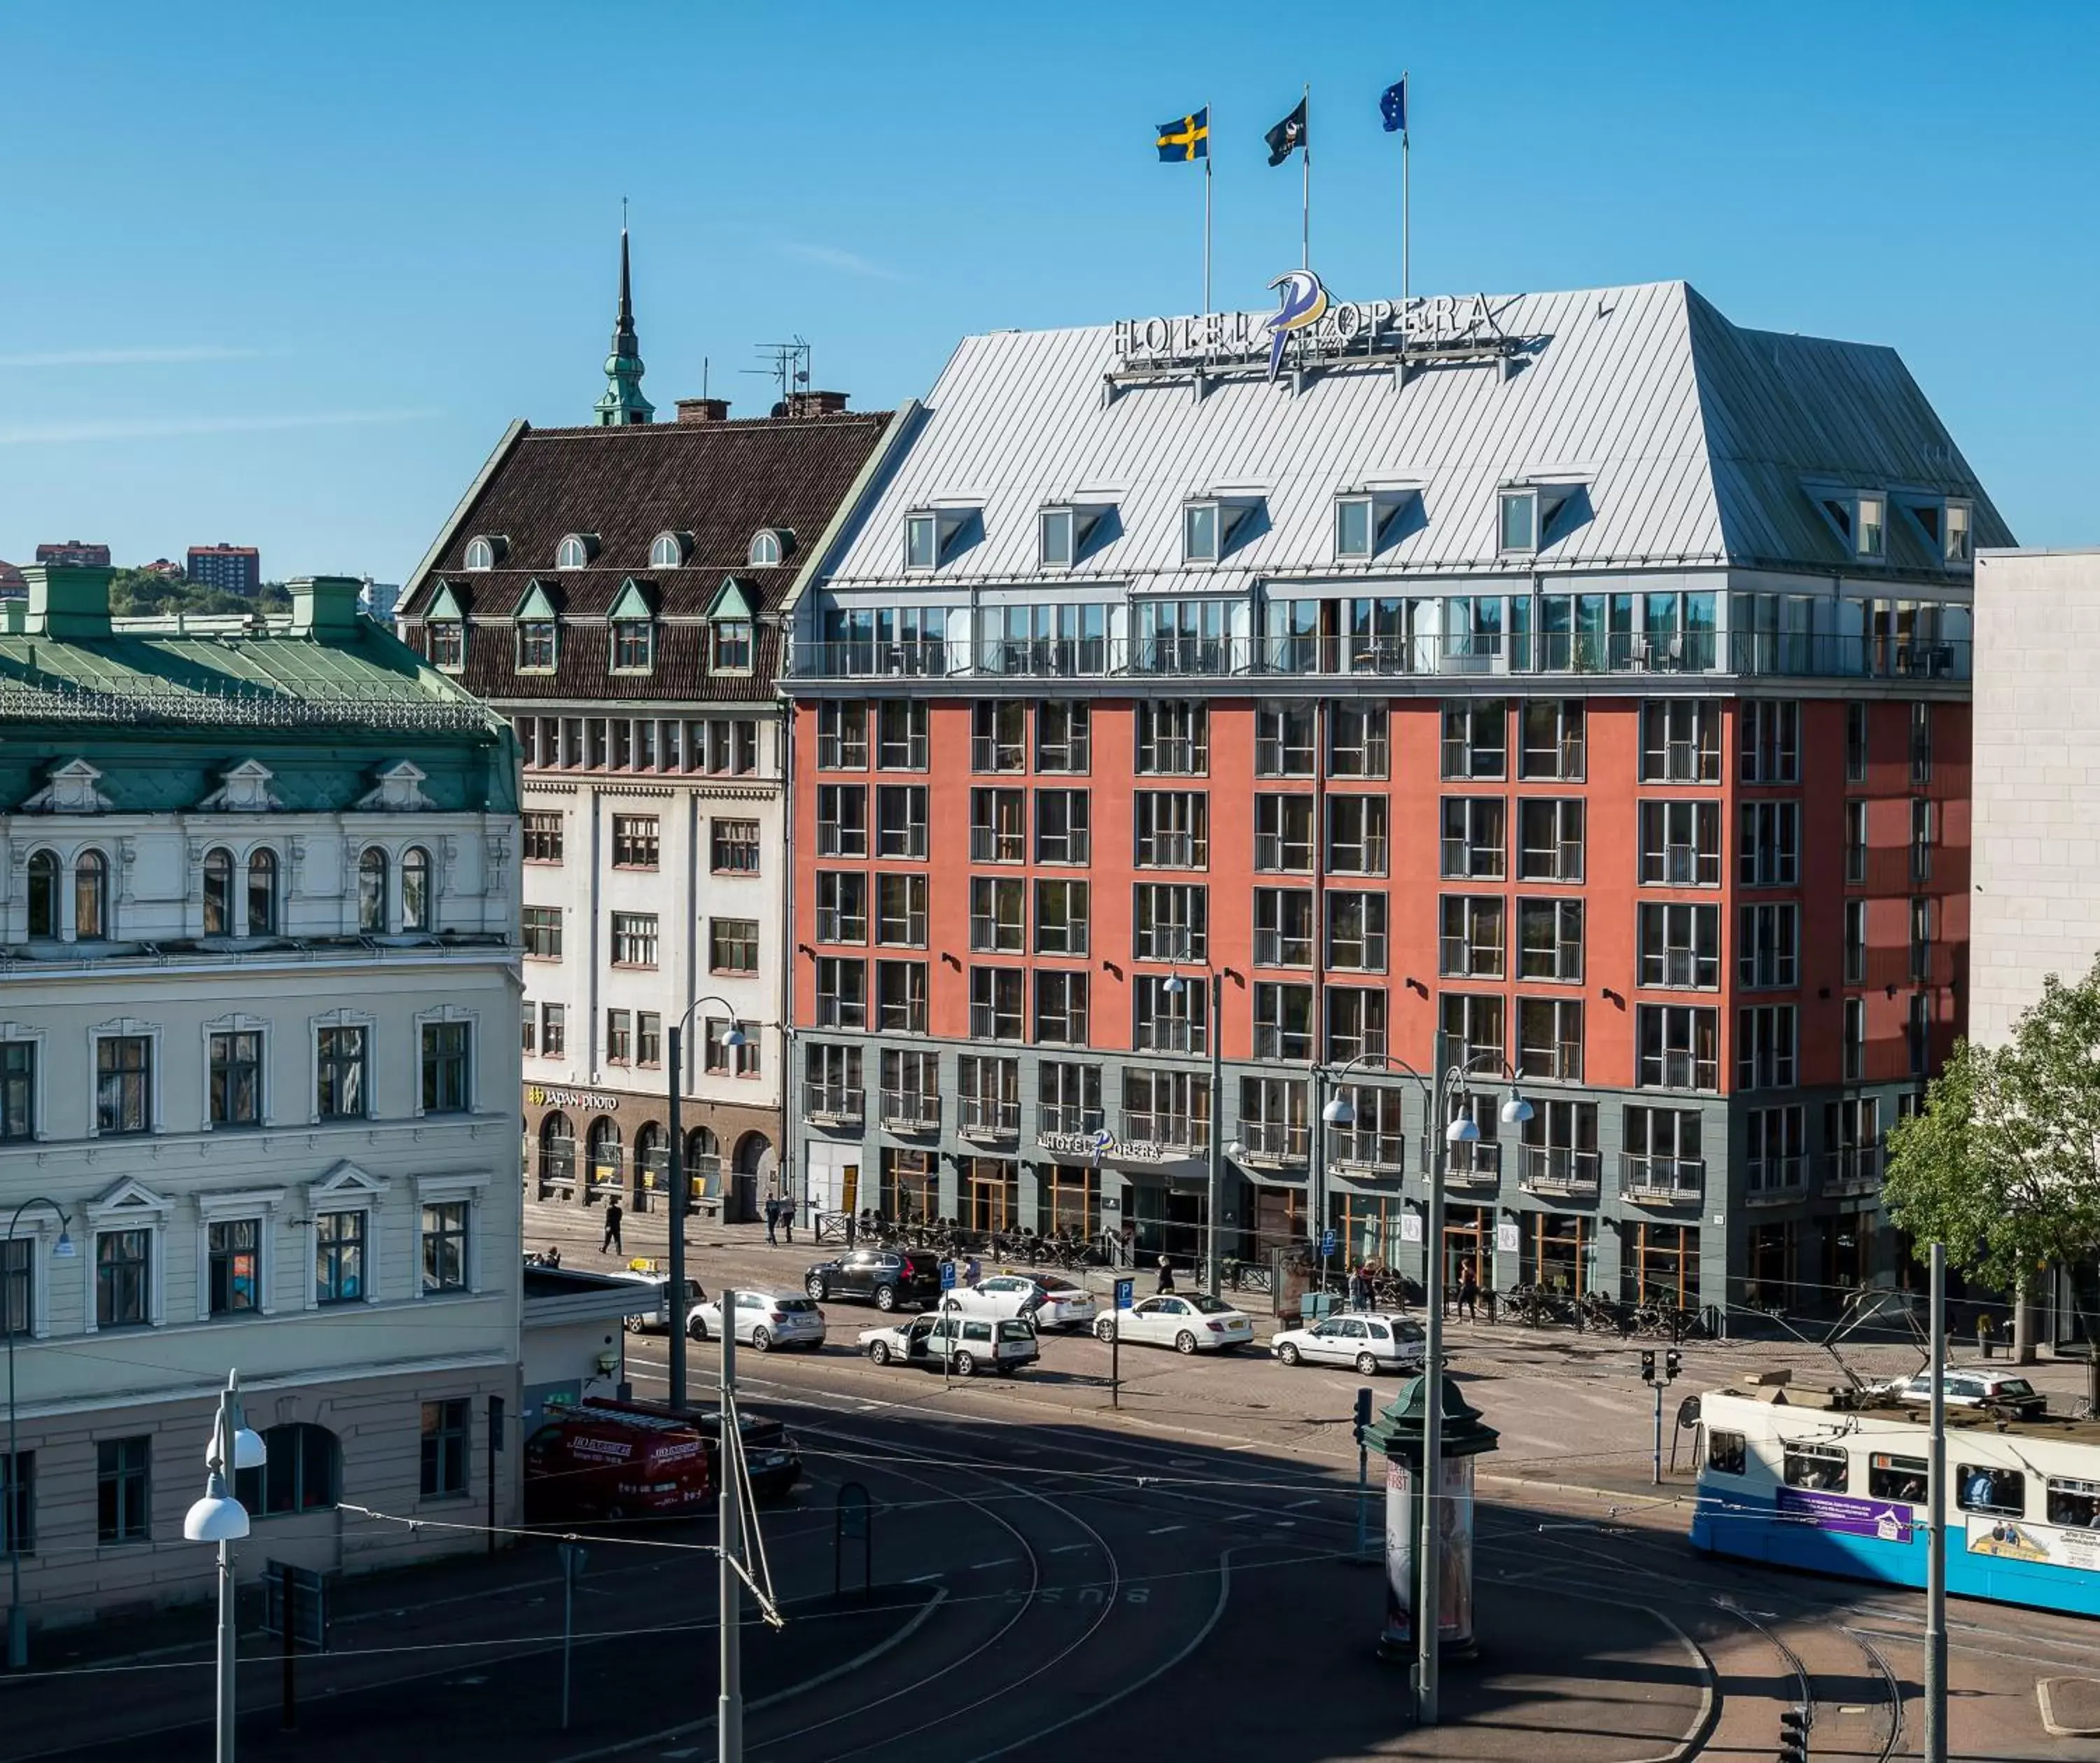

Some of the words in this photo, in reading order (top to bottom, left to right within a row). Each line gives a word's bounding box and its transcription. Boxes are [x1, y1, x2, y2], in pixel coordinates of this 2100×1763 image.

[1111, 311, 1250, 355] HOTEL
[1335, 293, 1496, 341] OPERA
[1046, 1135, 1091, 1152] HOTEL
[1114, 1143, 1161, 1159] OPERA
[1327, 1232, 1334, 1244] P
[946, 1265, 953, 1278] P
[1122, 1283, 1129, 1297] P
